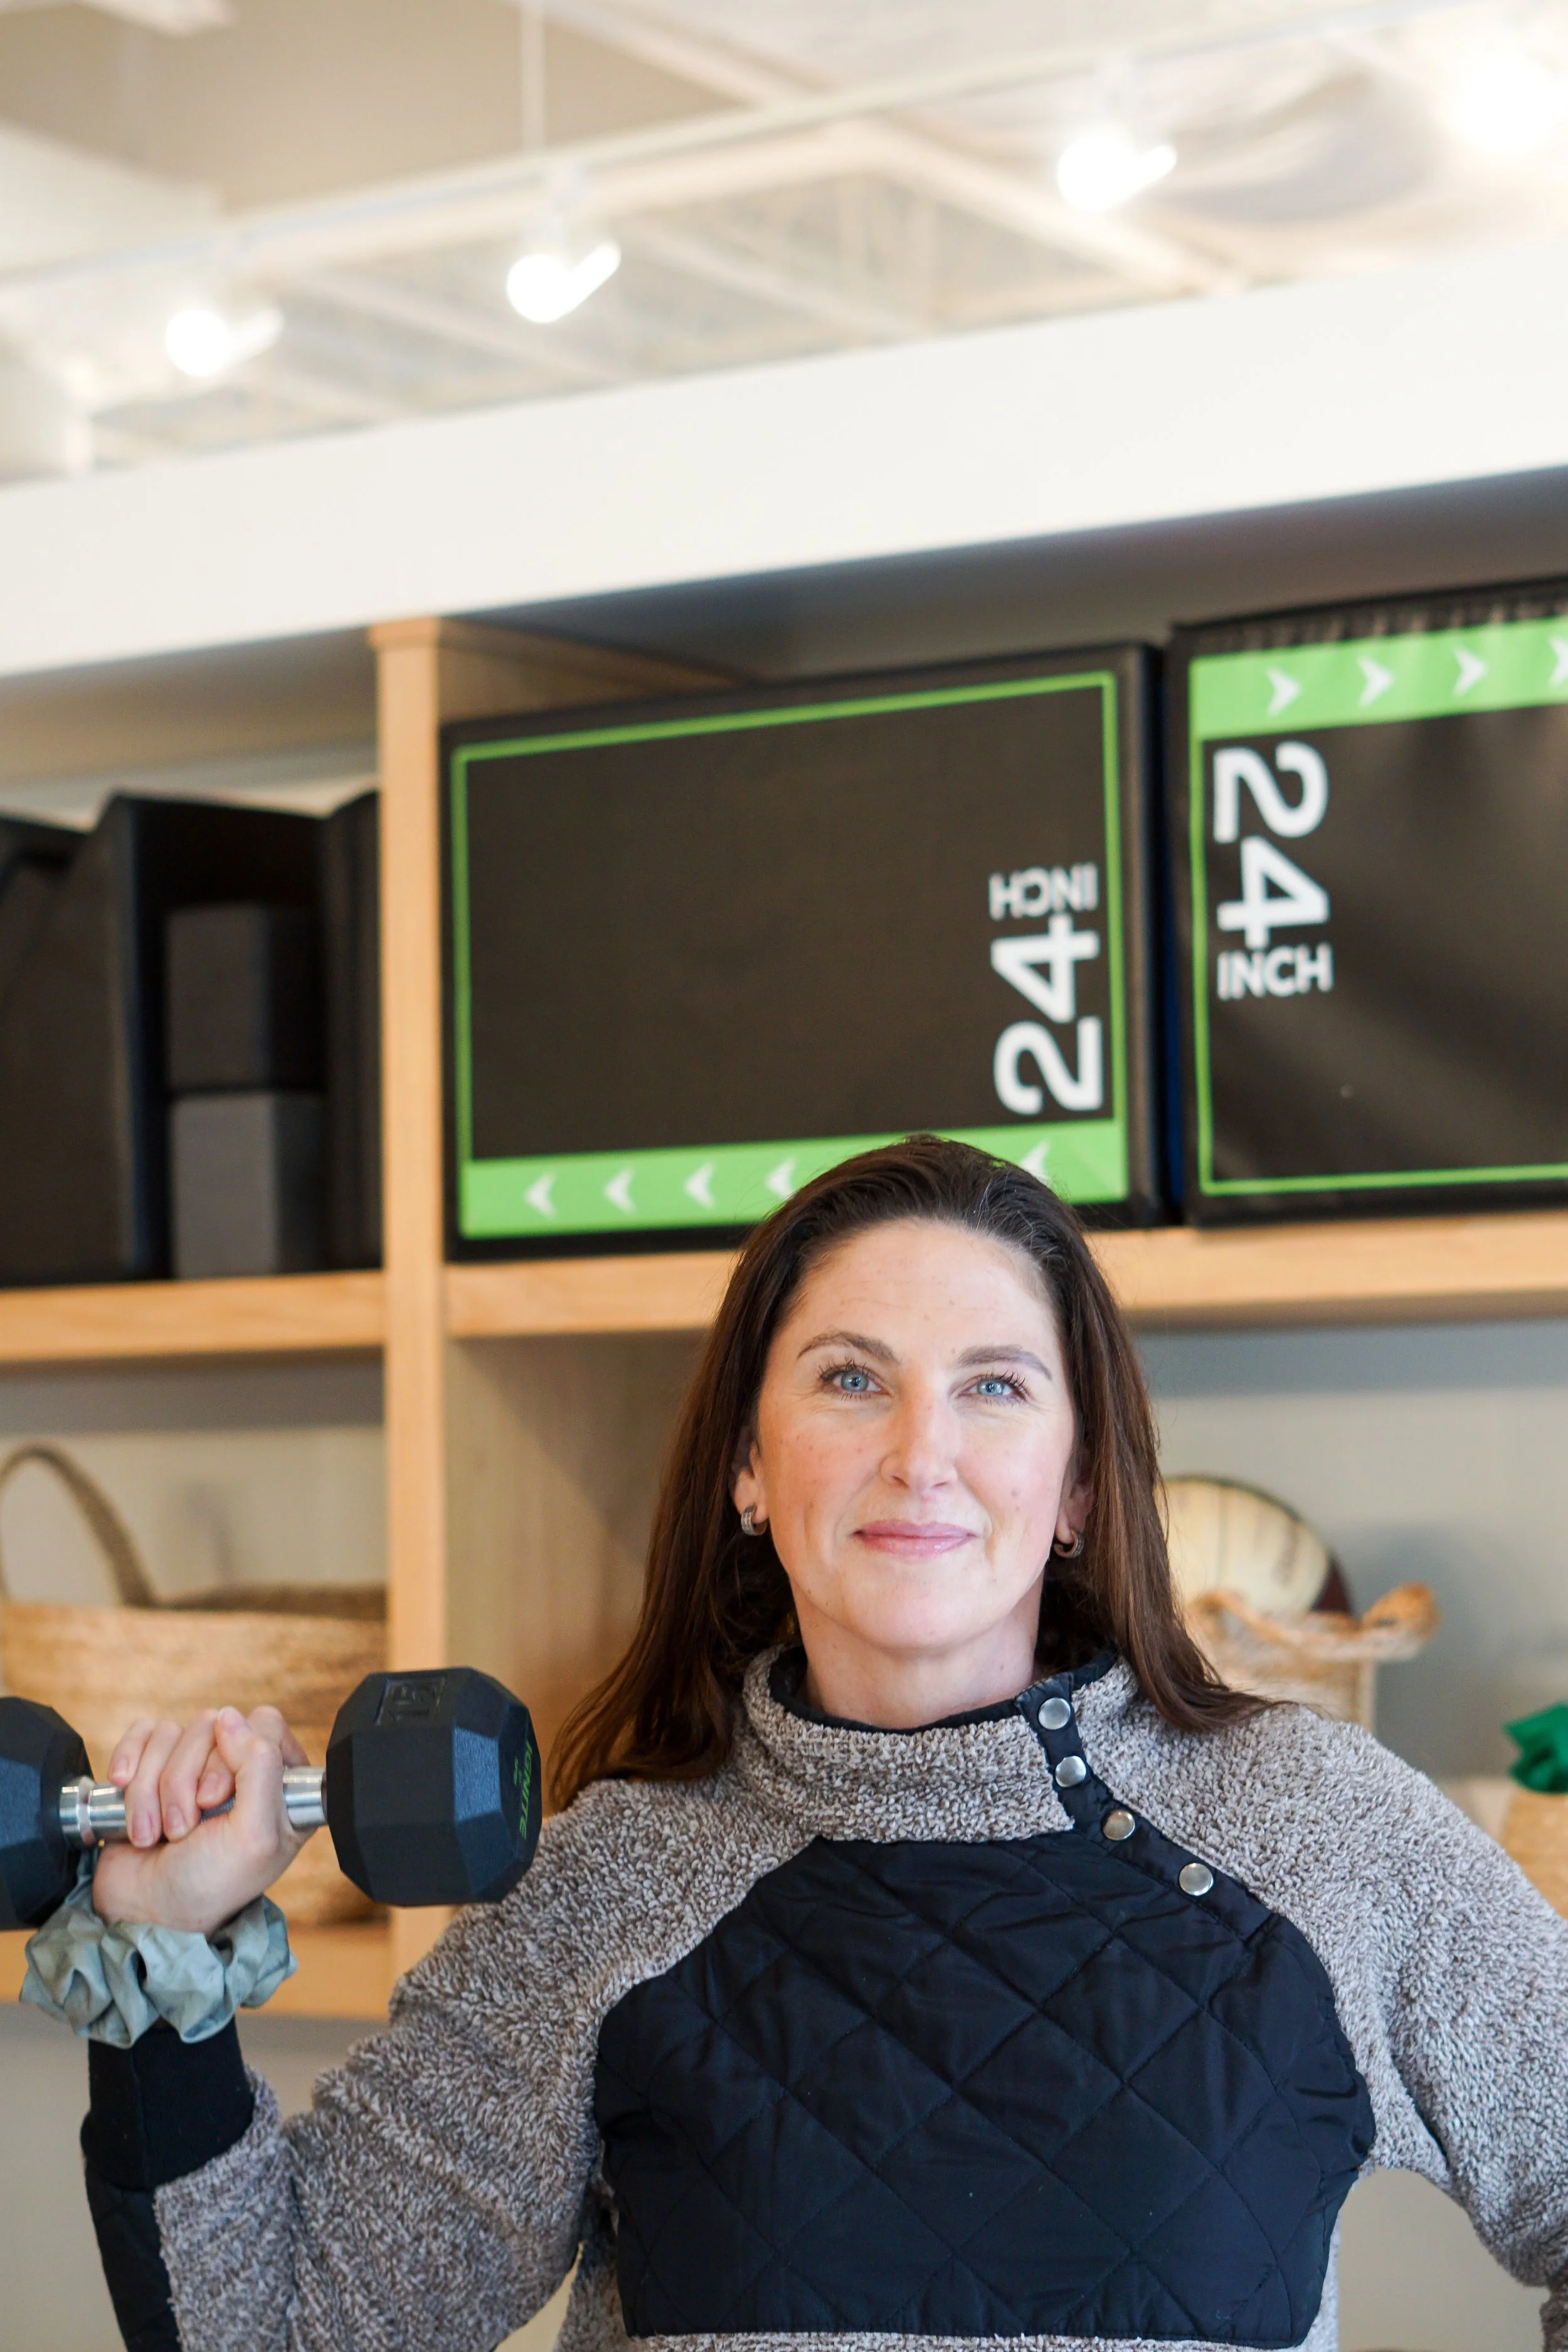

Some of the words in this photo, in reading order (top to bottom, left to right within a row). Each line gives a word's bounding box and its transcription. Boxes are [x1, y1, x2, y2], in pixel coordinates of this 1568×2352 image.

[988, 863, 1098, 919] INCH
[1213, 741, 1330, 950] 24
[990, 913, 1103, 1115] 24
[1217, 943, 1333, 1000] INCH
[519, 1739, 533, 1840] IGNITE
